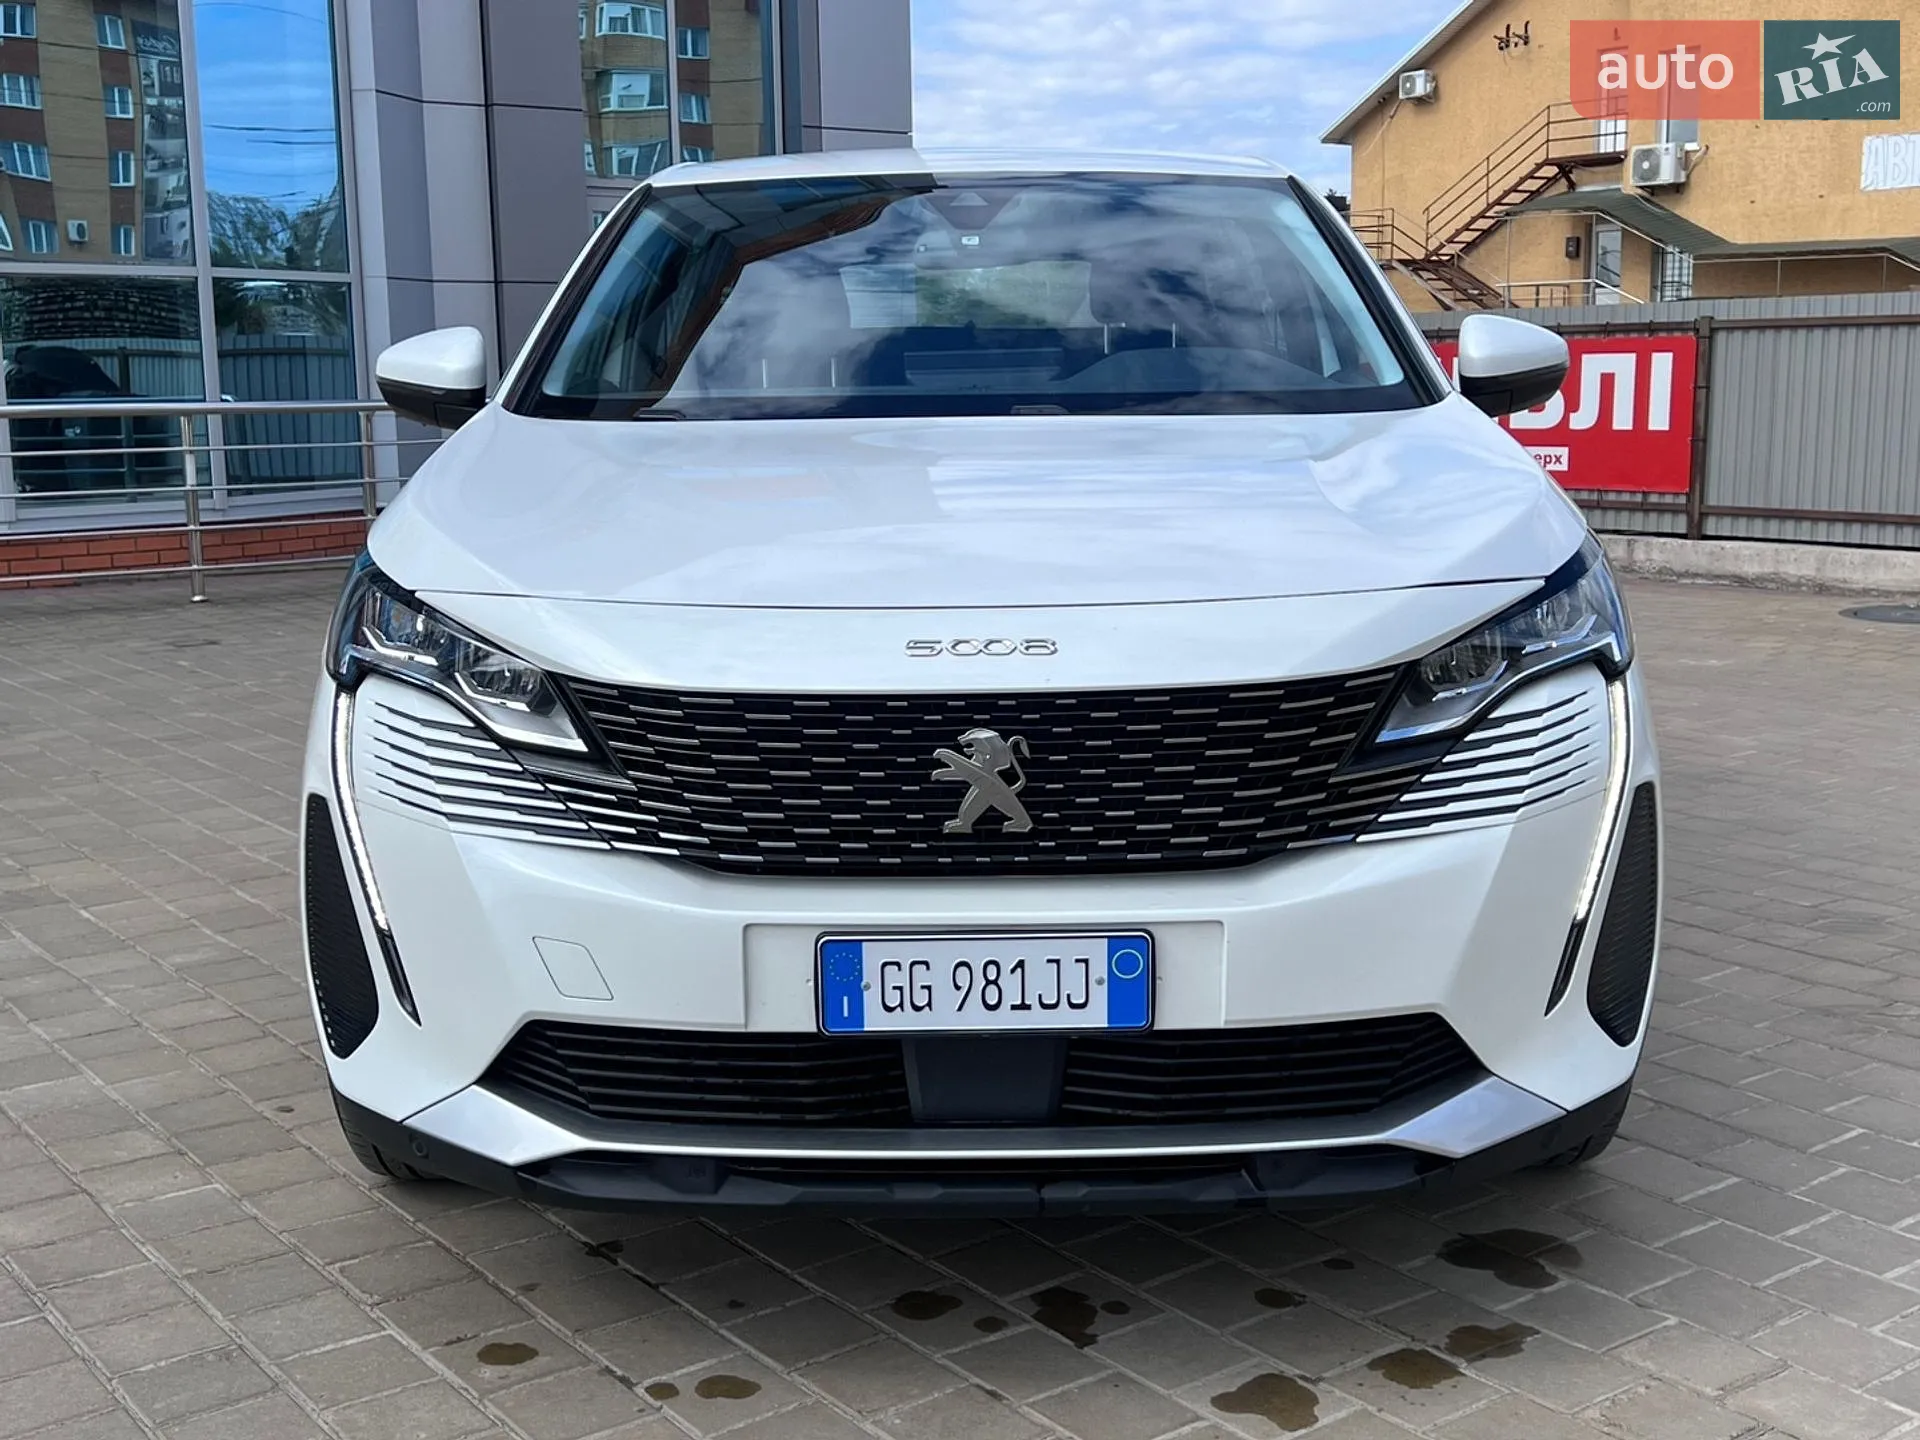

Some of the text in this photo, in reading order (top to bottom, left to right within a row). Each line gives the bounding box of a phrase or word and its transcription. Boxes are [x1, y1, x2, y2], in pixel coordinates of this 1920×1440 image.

[1534, 454, 1563, 468] ерх
[905, 639, 1058, 657] 5008
[879, 957, 1090, 1013] GG 981JJ
